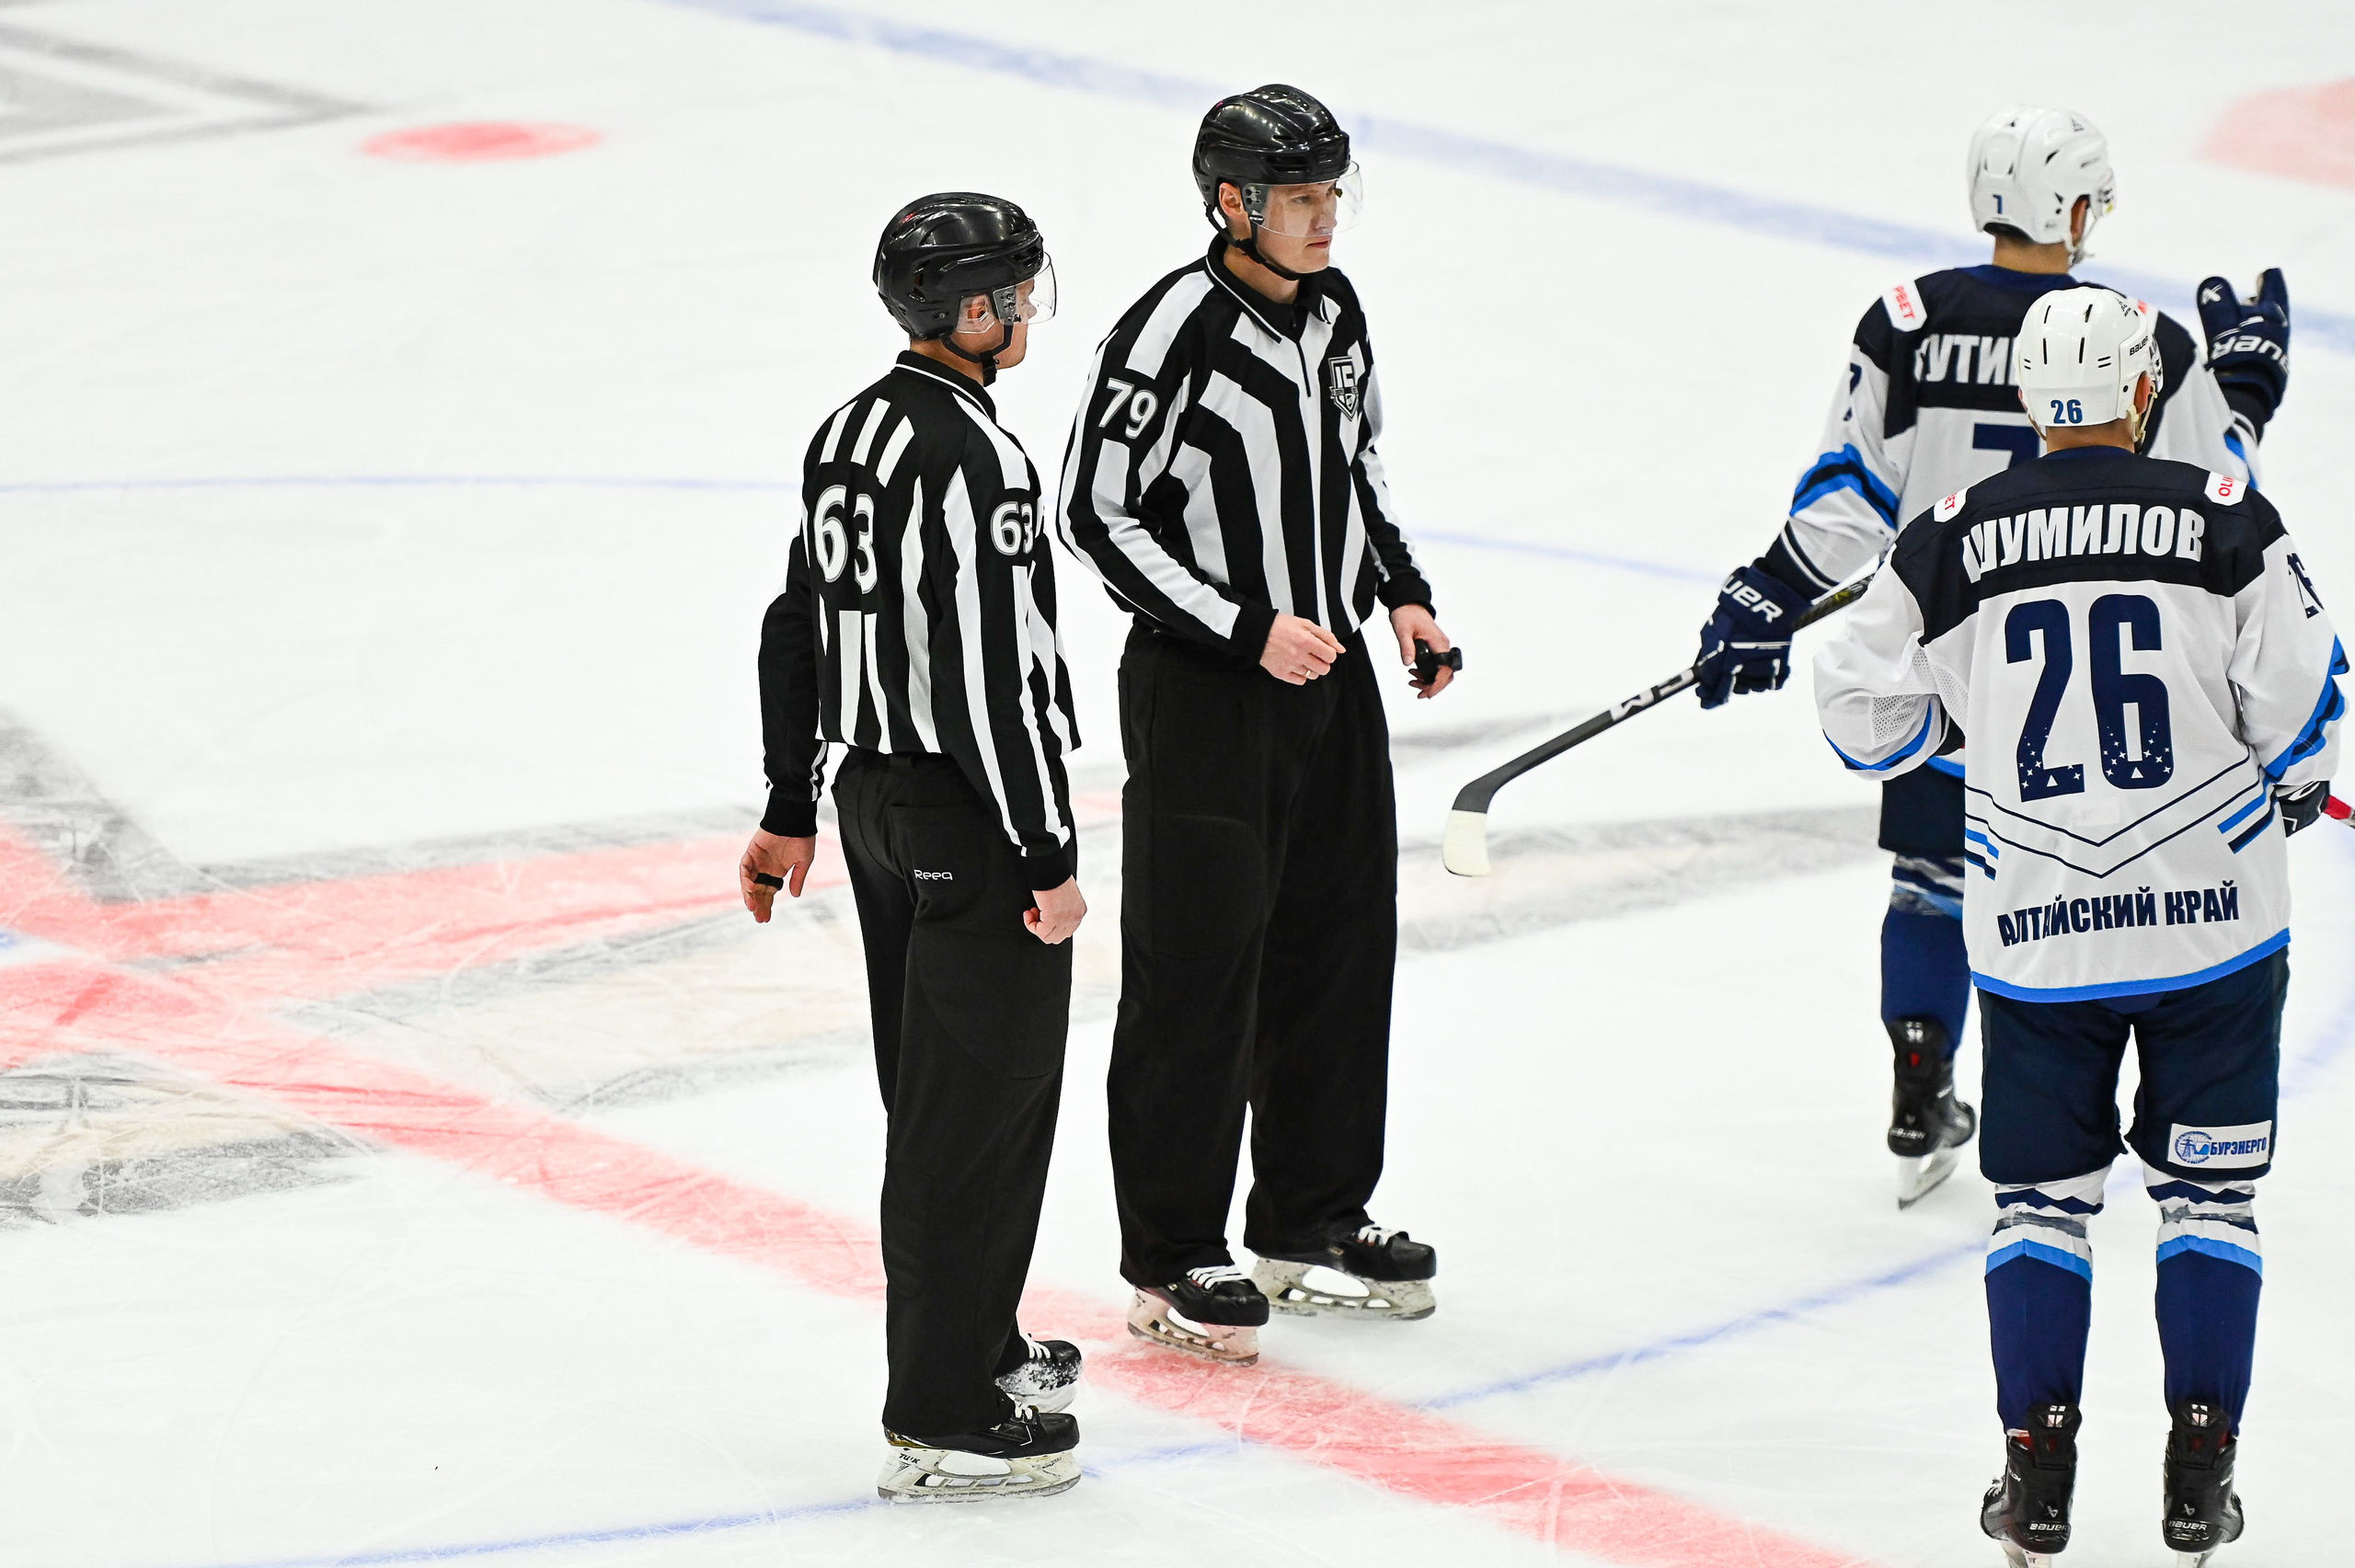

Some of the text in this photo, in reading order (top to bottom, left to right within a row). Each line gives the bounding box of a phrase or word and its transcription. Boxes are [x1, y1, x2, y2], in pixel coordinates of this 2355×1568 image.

[1098, 377, 1158, 439] 79
[2051, 398, 2084, 424] 26
[813, 484, 878, 595] 63
[990, 500, 1034, 556] 63
[1961, 503, 2206, 584] ШУМИЛОВ
[2005, 593, 2175, 803] 26
[1997, 879, 2240, 947] АЛТАЙСКИЙ КРАЙ
[2210, 1137, 2268, 1156] БУРЭНЕРГО
